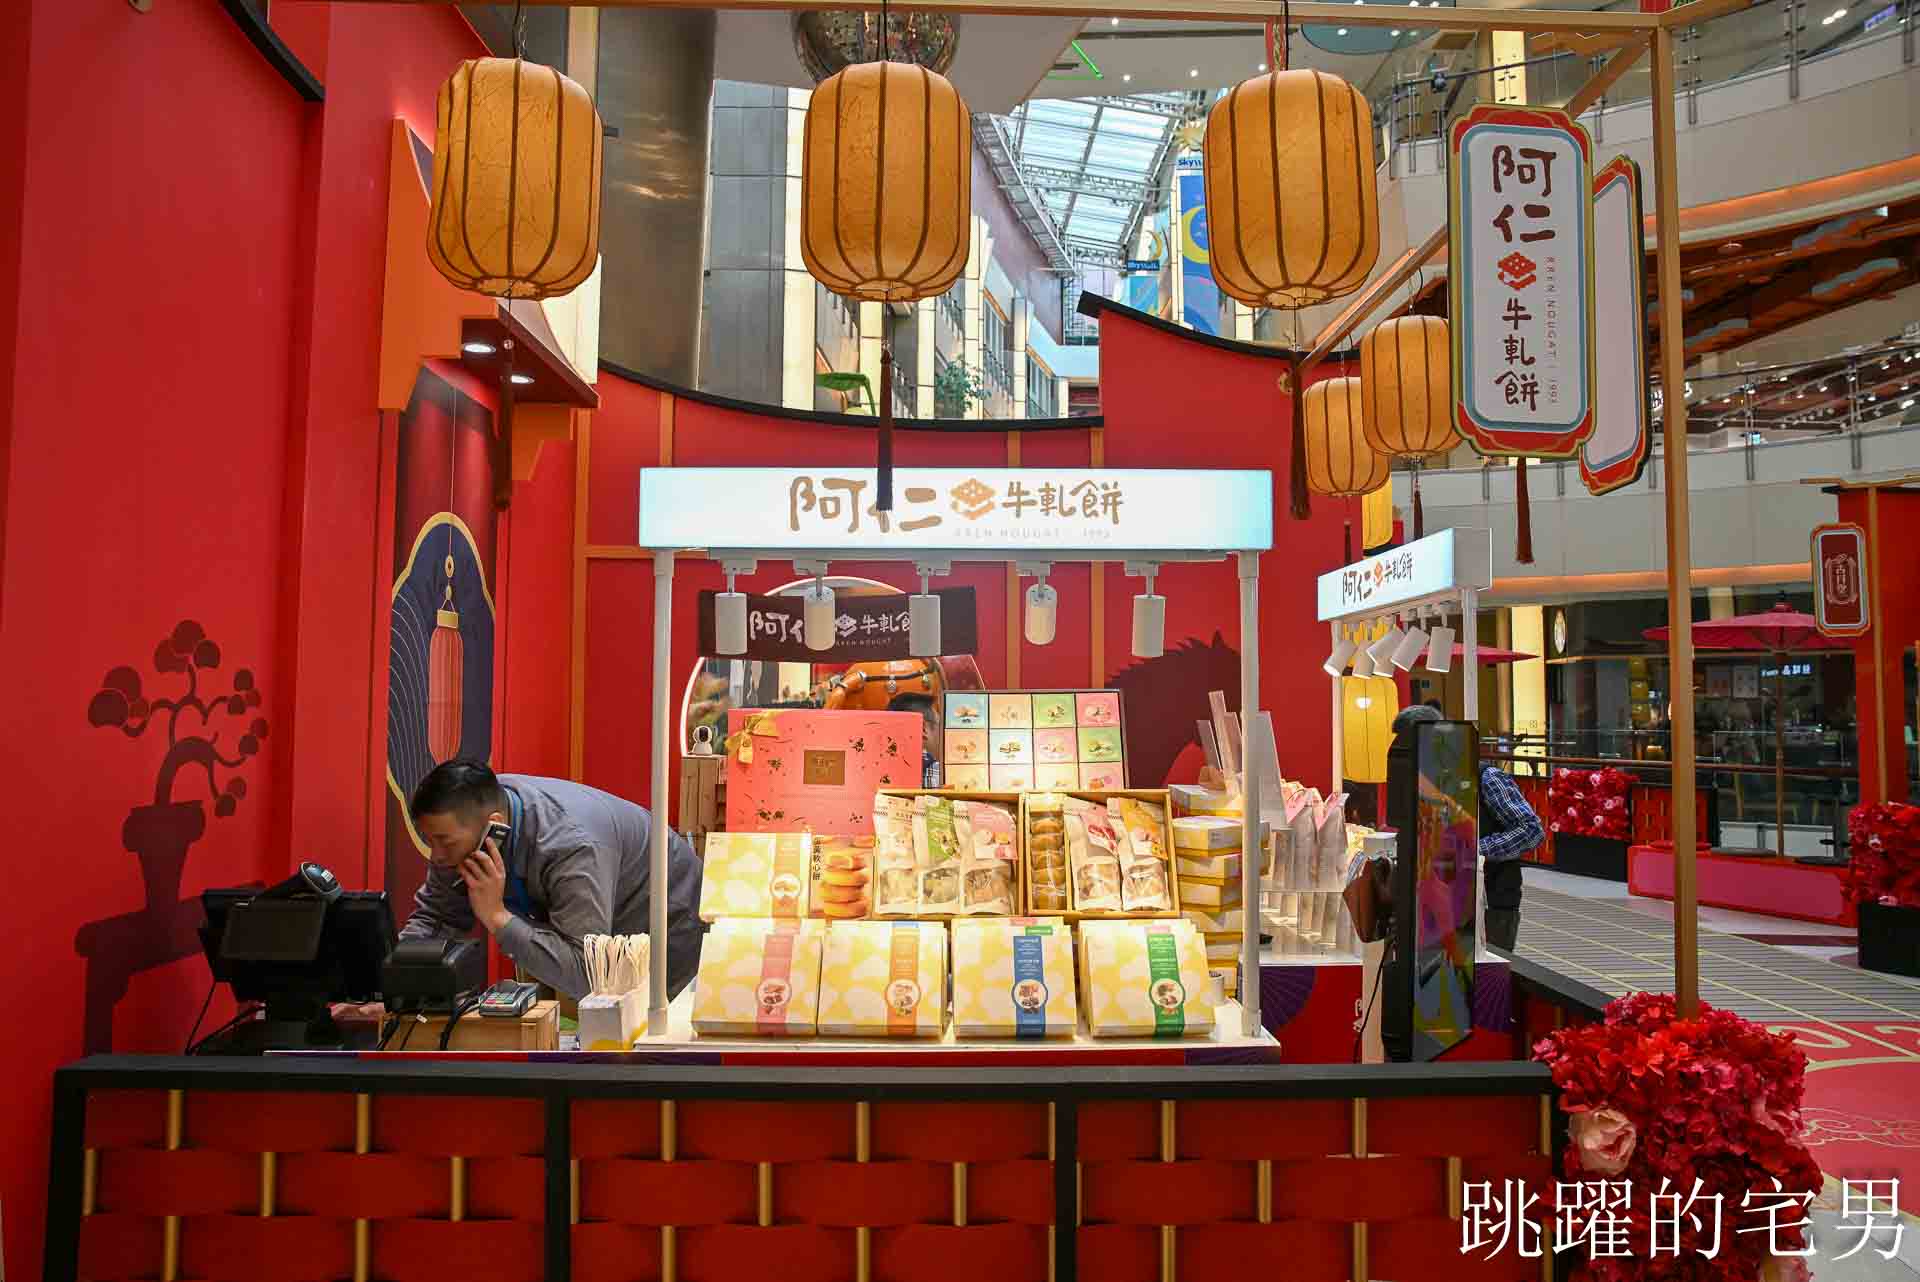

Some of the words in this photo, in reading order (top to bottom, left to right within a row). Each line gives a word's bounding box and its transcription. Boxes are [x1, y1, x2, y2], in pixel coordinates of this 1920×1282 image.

[1492, 144, 1557, 243] 阿仁
[1495, 297, 1541, 412] 牛軋餅
[789, 476, 943, 534] 阿仁
[1002, 479, 1124, 525] 牛軋餅
[1342, 567, 1373, 606] 阿仁
